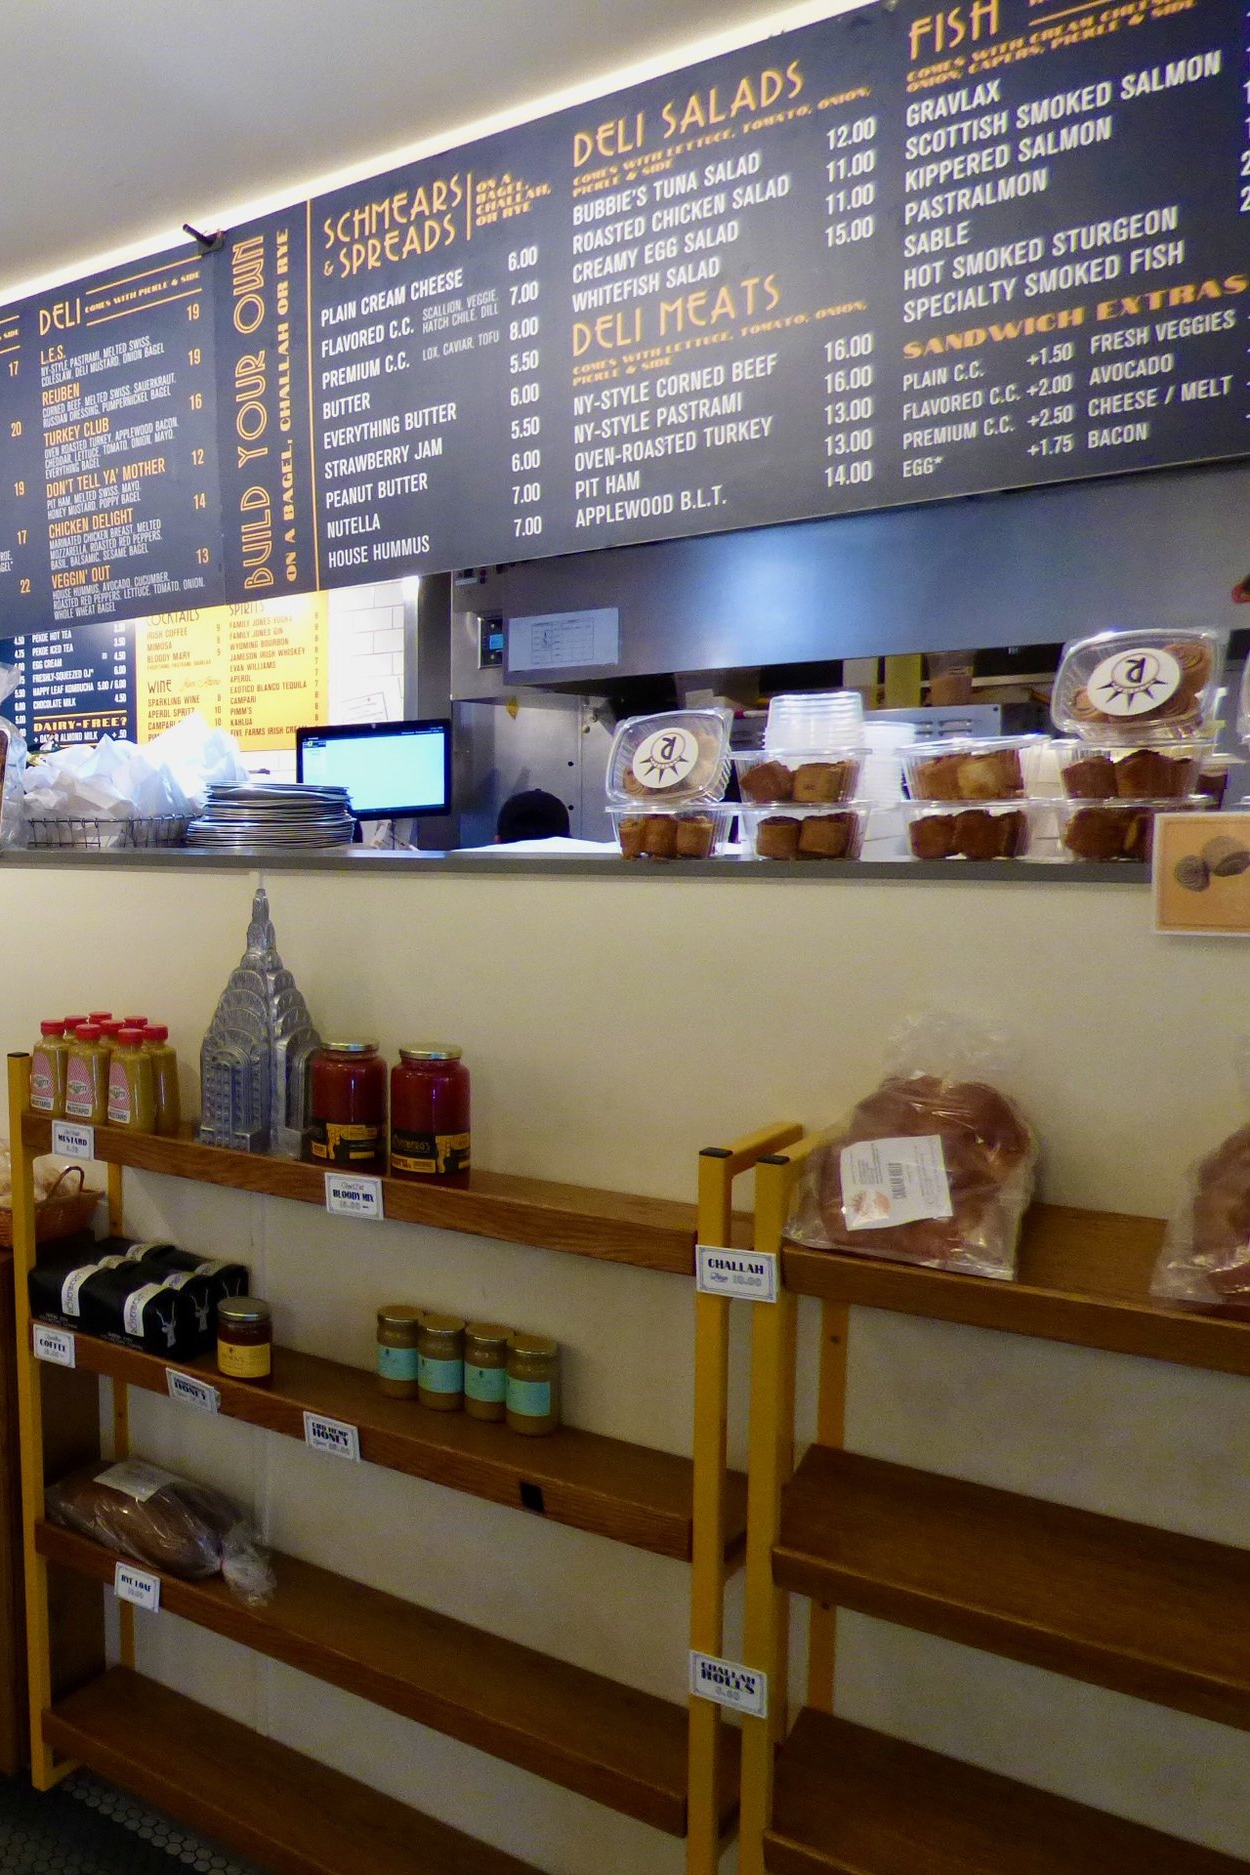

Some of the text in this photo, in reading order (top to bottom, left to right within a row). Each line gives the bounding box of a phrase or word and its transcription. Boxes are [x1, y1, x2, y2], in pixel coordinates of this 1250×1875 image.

[909, 0, 1000, 61] FISH
[573, 59, 801, 168] DELI SALADS
[906, 78, 1000, 128] GRAVLAX
[906, 50, 1222, 160] SCOTTISH SMOKED SALMON
[826, 115, 878, 150] 12.00
[905, 116, 1113, 192] KIPPERED SALMON
[573, 150, 762, 226] BUBBIE'S TUNA SALAD
[905, 168, 1048, 226] PASTRALMON
[324, 173, 462, 248] SCHMEARS
[572, 173, 791, 255] ROASTED CHICKEN SALAD
[276, 228, 288, 274] RYE
[323, 214, 455, 278] & SPREADS
[572, 219, 740, 284] CREAMY EGG SALAD
[904, 220, 972, 258] SABLE
[904, 204, 1178, 290] HOT SMOKED STURGEON
[508, 245, 538, 272] 6.00
[277, 280, 289, 316] OR
[322, 268, 463, 326] PLAIN CREAM CHEESE
[572, 254, 721, 312] WHITEFISH SALAD
[904, 240, 1185, 324] SPECIALTY SMOKED FISH
[39, 298, 80, 336] DELI
[572, 273, 780, 357] DELI MEATS
[902, 274, 1249, 360] SANDWICH EXTRAS
[1091, 309, 1236, 354] FRESH VEGGIES
[41, 344, 66, 364] L.E.S.
[322, 317, 414, 358] FLAVORED C.C.
[1026, 342, 1074, 366] +1.50
[277, 322, 290, 432] CHALLAH
[322, 351, 410, 390] PREMIUM C.C.
[574, 352, 778, 416] NY-STYLE CORNED BEEF
[903, 361, 985, 392] PLAIN C.C.
[1089, 353, 1174, 386] AVOCADO
[42, 383, 80, 406] REUBEN
[232, 236, 274, 590] BUILD YOUR OWN
[323, 392, 370, 420] BUTTER
[903, 384, 1021, 421] FLAVORED C.C.
[1088, 389, 1157, 418] CHEESE
[1181, 376, 1234, 403] MELT
[44, 418, 109, 447] TURKEY CLUB
[324, 402, 457, 450] EVERYTHING BUTTER
[574, 392, 743, 444] NY-STYLE PASTRAMI
[903, 415, 1016, 450] PREMIUM C.C.
[1088, 421, 1150, 449] BACON
[324, 437, 443, 480] STRAWBERRY JAM
[574, 416, 774, 472] OVEN-ROASTED TURKEY
[1027, 434, 1074, 456] +1.75
[78, 475, 100, 490] TELL
[123, 458, 166, 479] MOTHER
[326, 472, 428, 509] PEANUT BUTTER
[576, 471, 640, 500] PIT HAM
[49, 508, 133, 538] CHICKEN DELIGHT
[576, 485, 726, 528] APPLEWOOD B.L.T.
[285, 528, 296, 542] A
[328, 513, 381, 539] NUTELLA
[286, 552, 297, 582] ON
[328, 536, 430, 568] HOUSE HUMMUS
[92, 566, 110, 582] OUT
[148, 680, 172, 694] WINE
[34, 716, 128, 732] DAIRY-FREE?
[58, 1134, 88, 1146] MUSTARD
[332, 1190, 360, 1200] BLOODY
[708, 1258, 764, 1275] CHALLAH
[40, 1338, 66, 1352] COFFEE
[174, 1382, 206, 1401] HONEY
[312, 1430, 348, 1447] HONEY
[702, 1662, 755, 1685] CHALLAH
[702, 1668, 754, 1694] ROLLS
